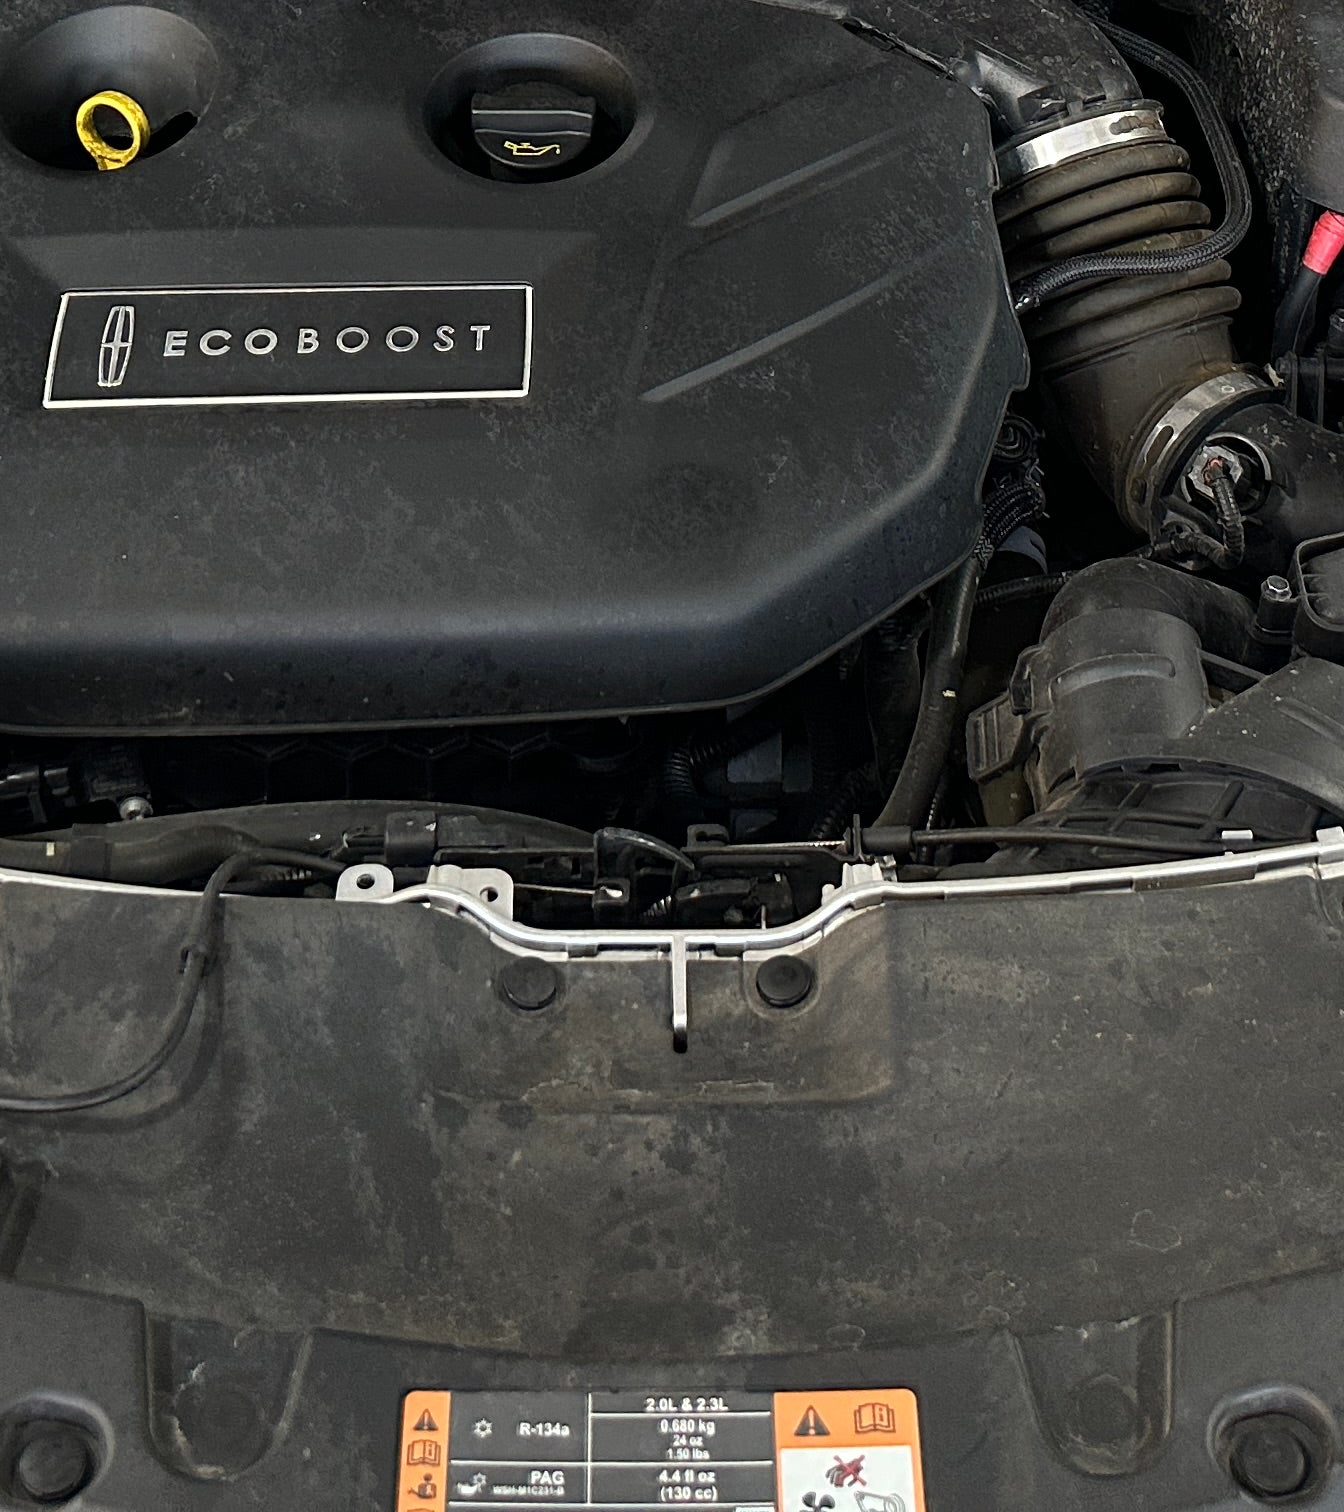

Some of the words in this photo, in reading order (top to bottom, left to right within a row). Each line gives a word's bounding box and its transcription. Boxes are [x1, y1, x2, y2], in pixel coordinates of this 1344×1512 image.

[163, 324, 491, 357] ECOBOOST
[646, 1397, 677, 1412] 2.0L
[681, 1397, 693, 1412] &
[697, 1397, 728, 1411] 2.3L
[519, 1422, 570, 1437] R-134a
[660, 1419, 695, 1434] 0.680
[698, 1419, 716, 1435] kg
[673, 1435, 687, 1446] 24
[690, 1437, 703, 1446] oz
[667, 1448, 690, 1459] 1.50
[692, 1448, 710, 1459] lbs
[530, 1470, 565, 1485] PAG
[659, 1470, 681, 1483] 4.4
[684, 1469, 694, 1483] fl
[698, 1472, 715, 1482] oz
[661, 1486, 690, 1501] (130
[695, 1486, 718, 1502] cc)
